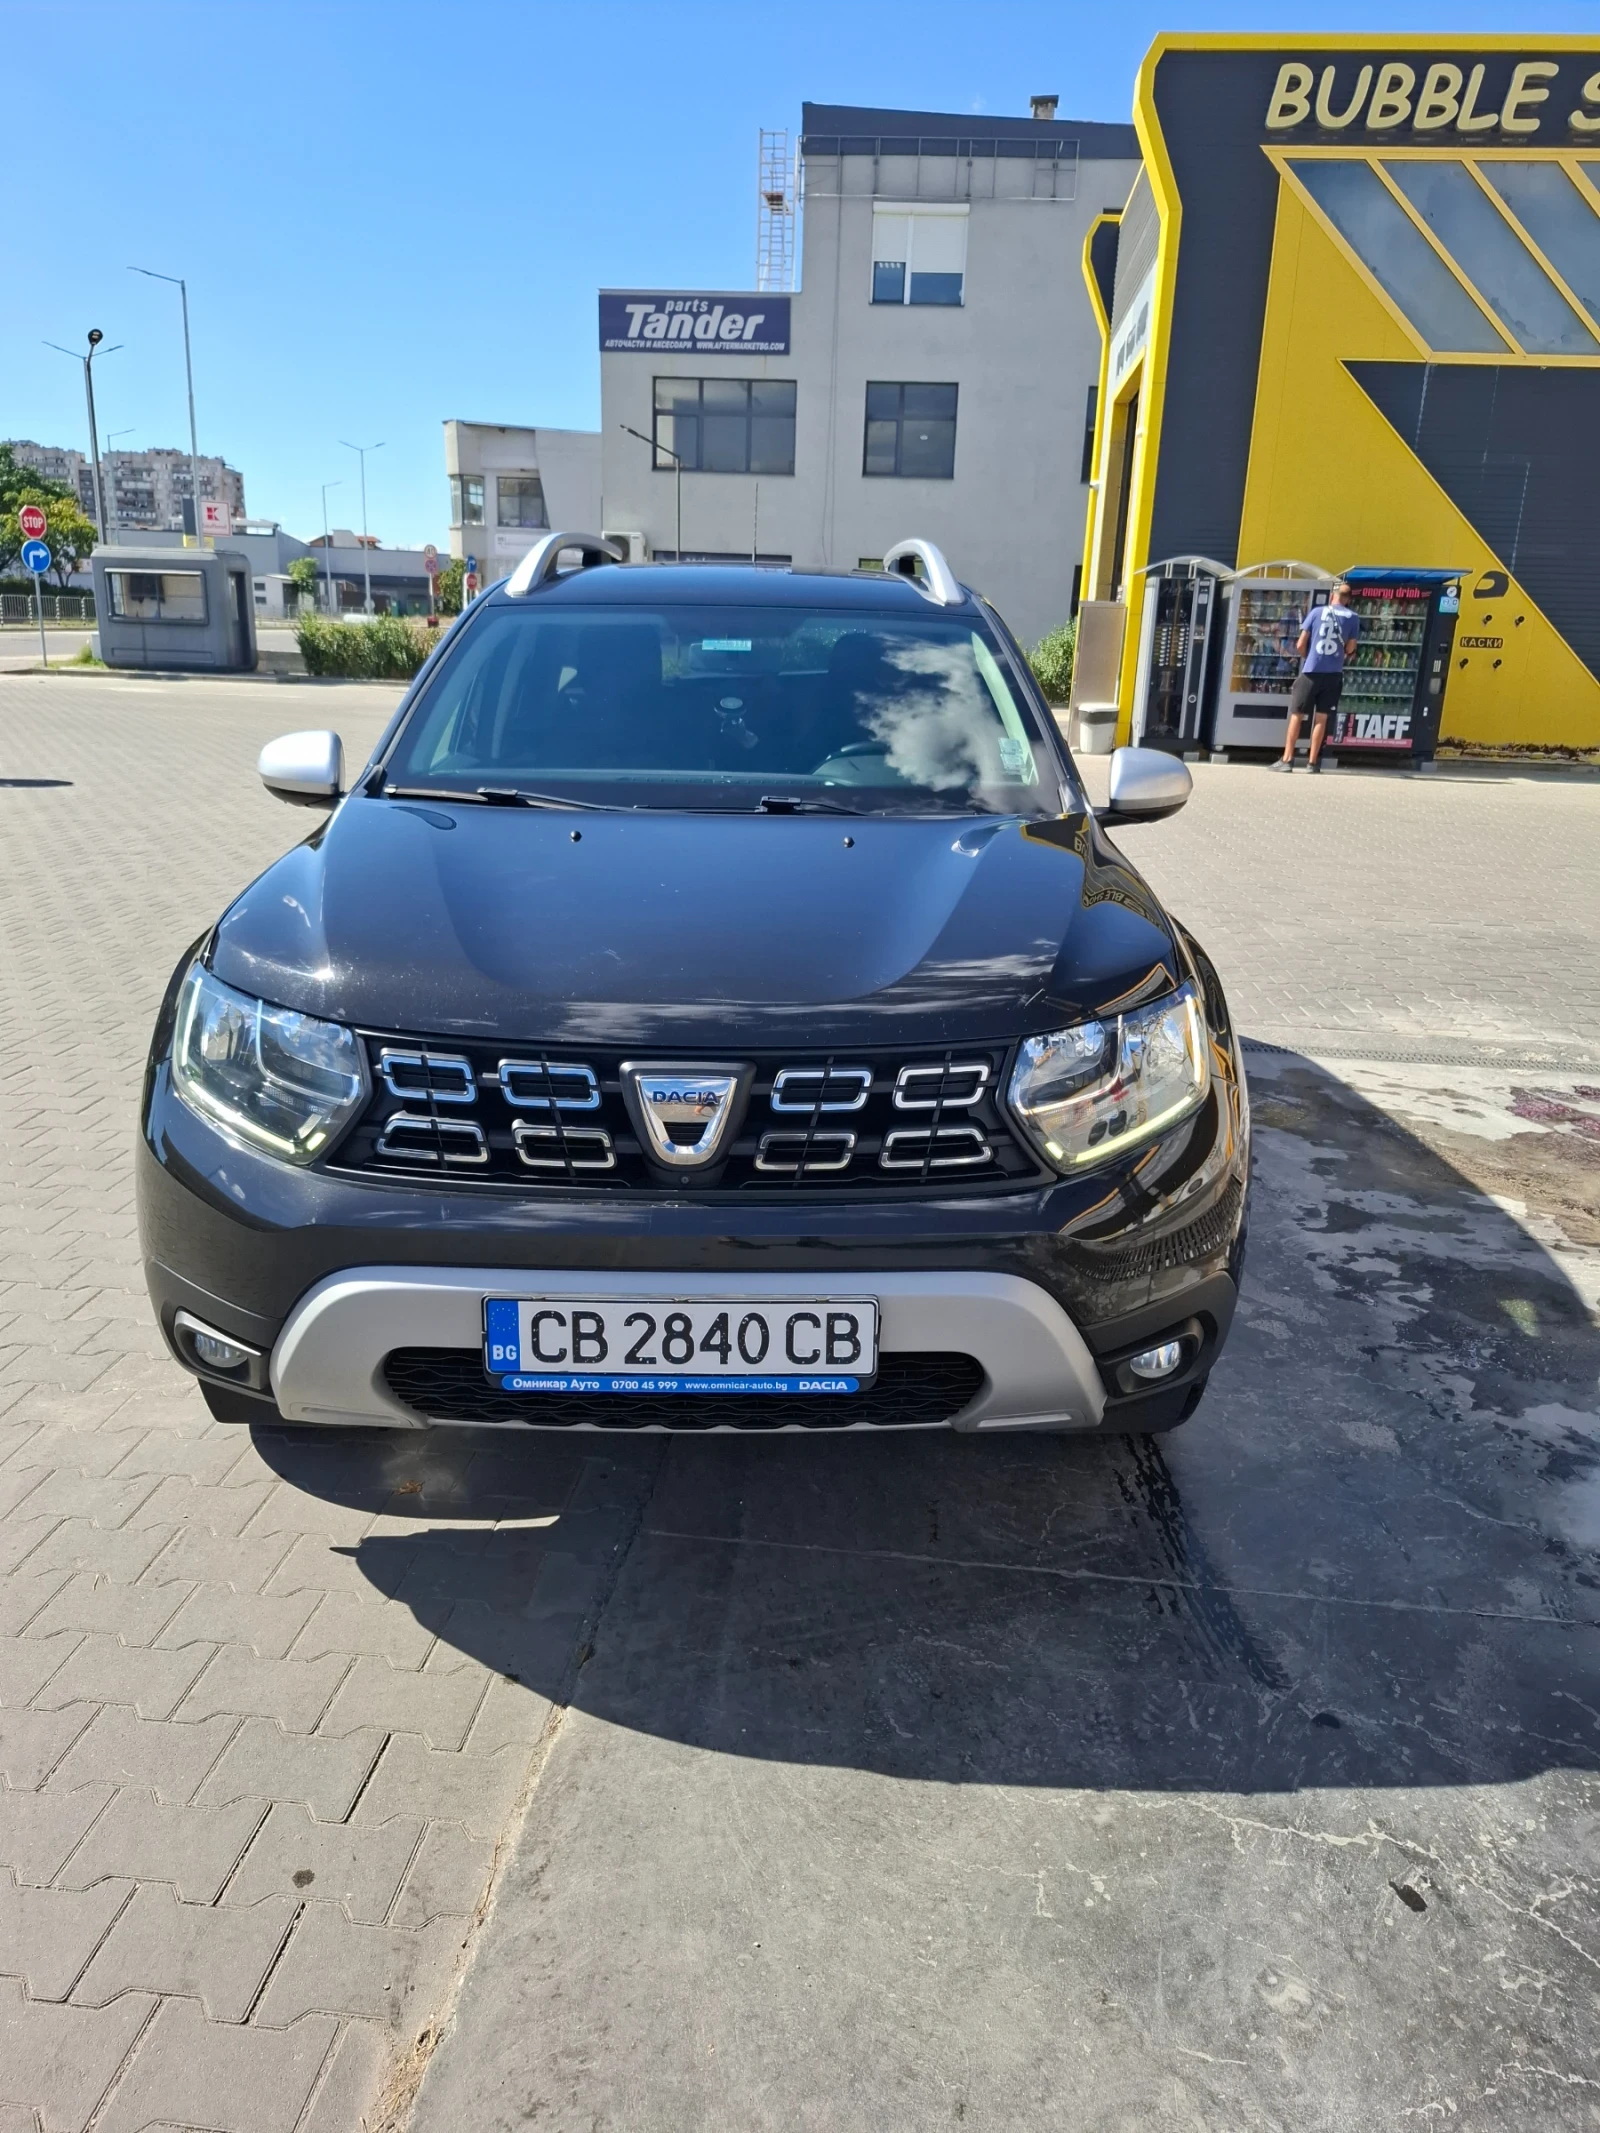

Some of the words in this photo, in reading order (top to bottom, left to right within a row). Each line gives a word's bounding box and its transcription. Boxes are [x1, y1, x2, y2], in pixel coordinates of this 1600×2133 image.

[1265, 62, 1559, 132] BUBBLE
[665, 299, 708, 314] parts
[625, 304, 765, 340] Tander
[605, 339, 645, 348] АВТОЧАСТИ
[646, 340, 652, 348] И
[23, 515, 44, 529] STOP
[1362, 587, 1394, 599] energy
[1461, 637, 1502, 648] КАСКИ
[653, 1091, 719, 1105] DACIA
[531, 1310, 608, 1364] CB
[624, 1312, 770, 1365] 2840
[786, 1312, 862, 1365] CB
[492, 1344, 517, 1361] BG
[512, 1378, 567, 1390] Омникар
[570, 1378, 600, 1390] Ауто
[611, 1381, 639, 1390] 0700
[641, 1381, 655, 1390] 45
[657, 1381, 678, 1390] 999
[685, 1381, 788, 1391] www.omnicar-auto.bg
[799, 1381, 848, 1391] DACIA
